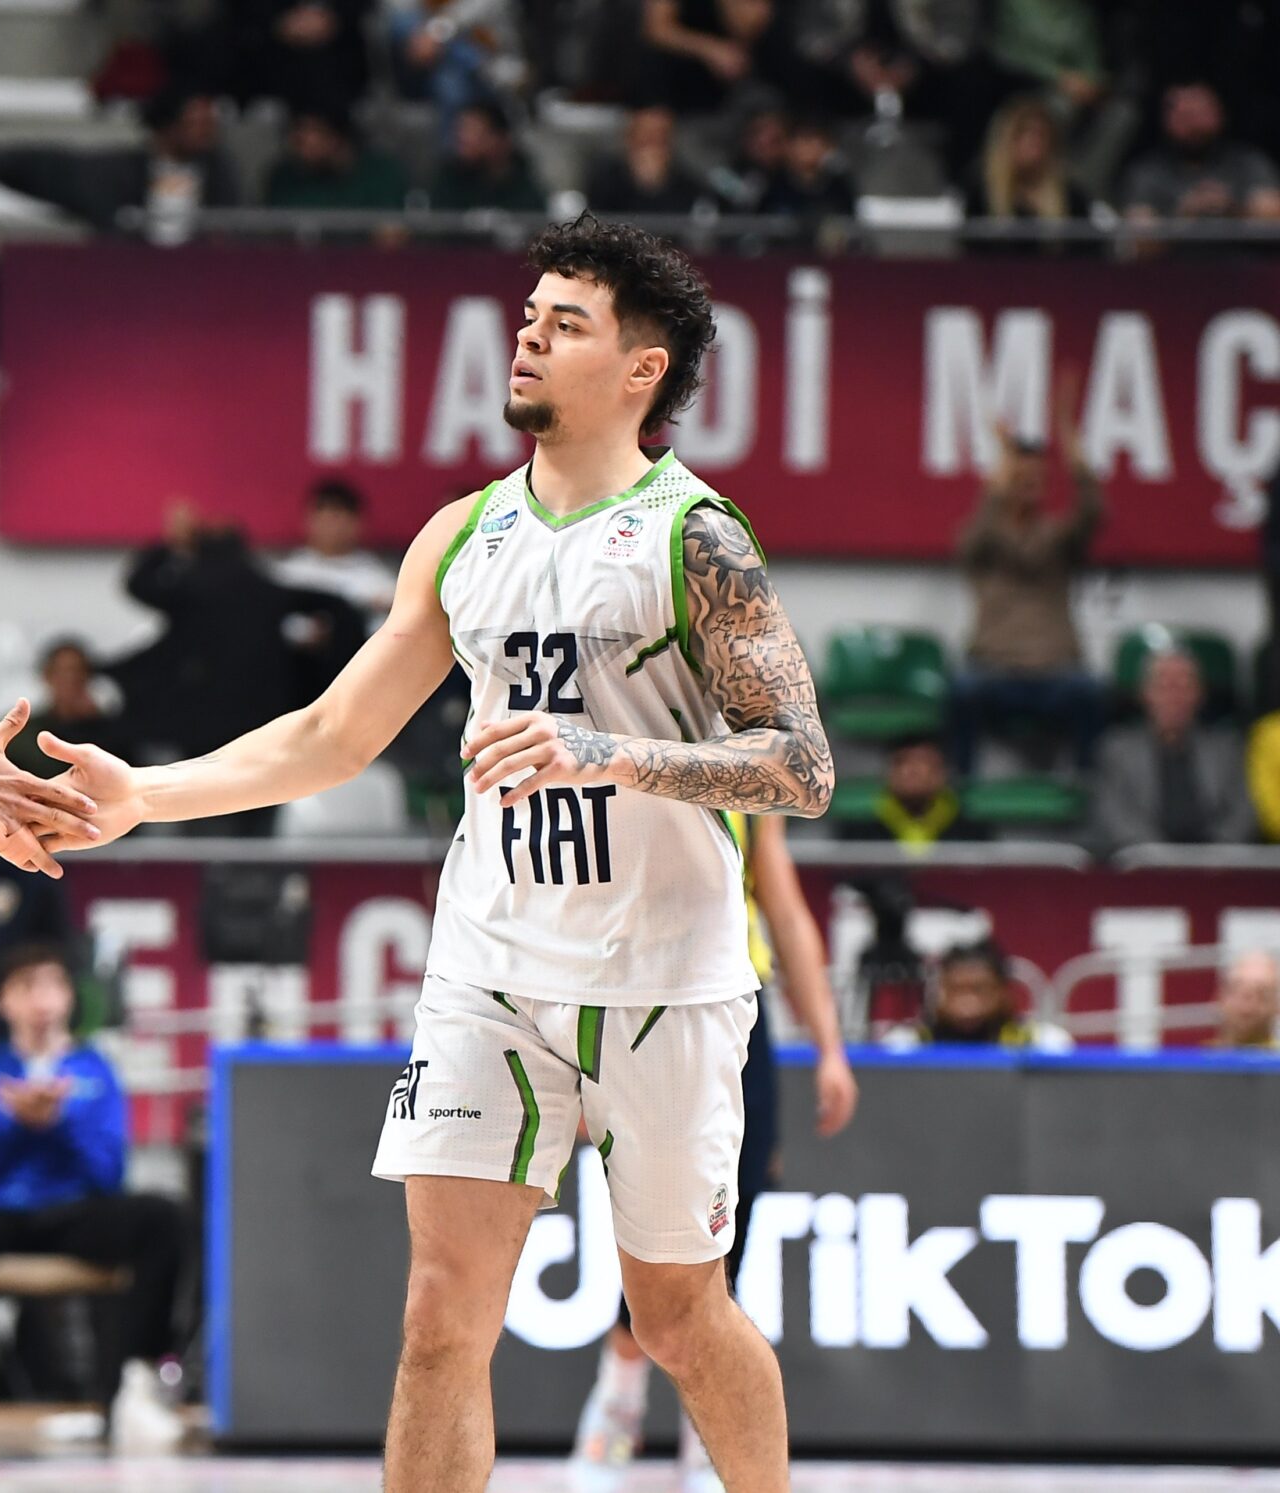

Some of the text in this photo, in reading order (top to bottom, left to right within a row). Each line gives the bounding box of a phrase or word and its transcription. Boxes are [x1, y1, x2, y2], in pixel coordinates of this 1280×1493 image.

[307, 268, 833, 472] HADİ
[504, 631, 584, 713] 32
[499, 783, 617, 885] FIAT
[428, 1105, 482, 1120] sportive
